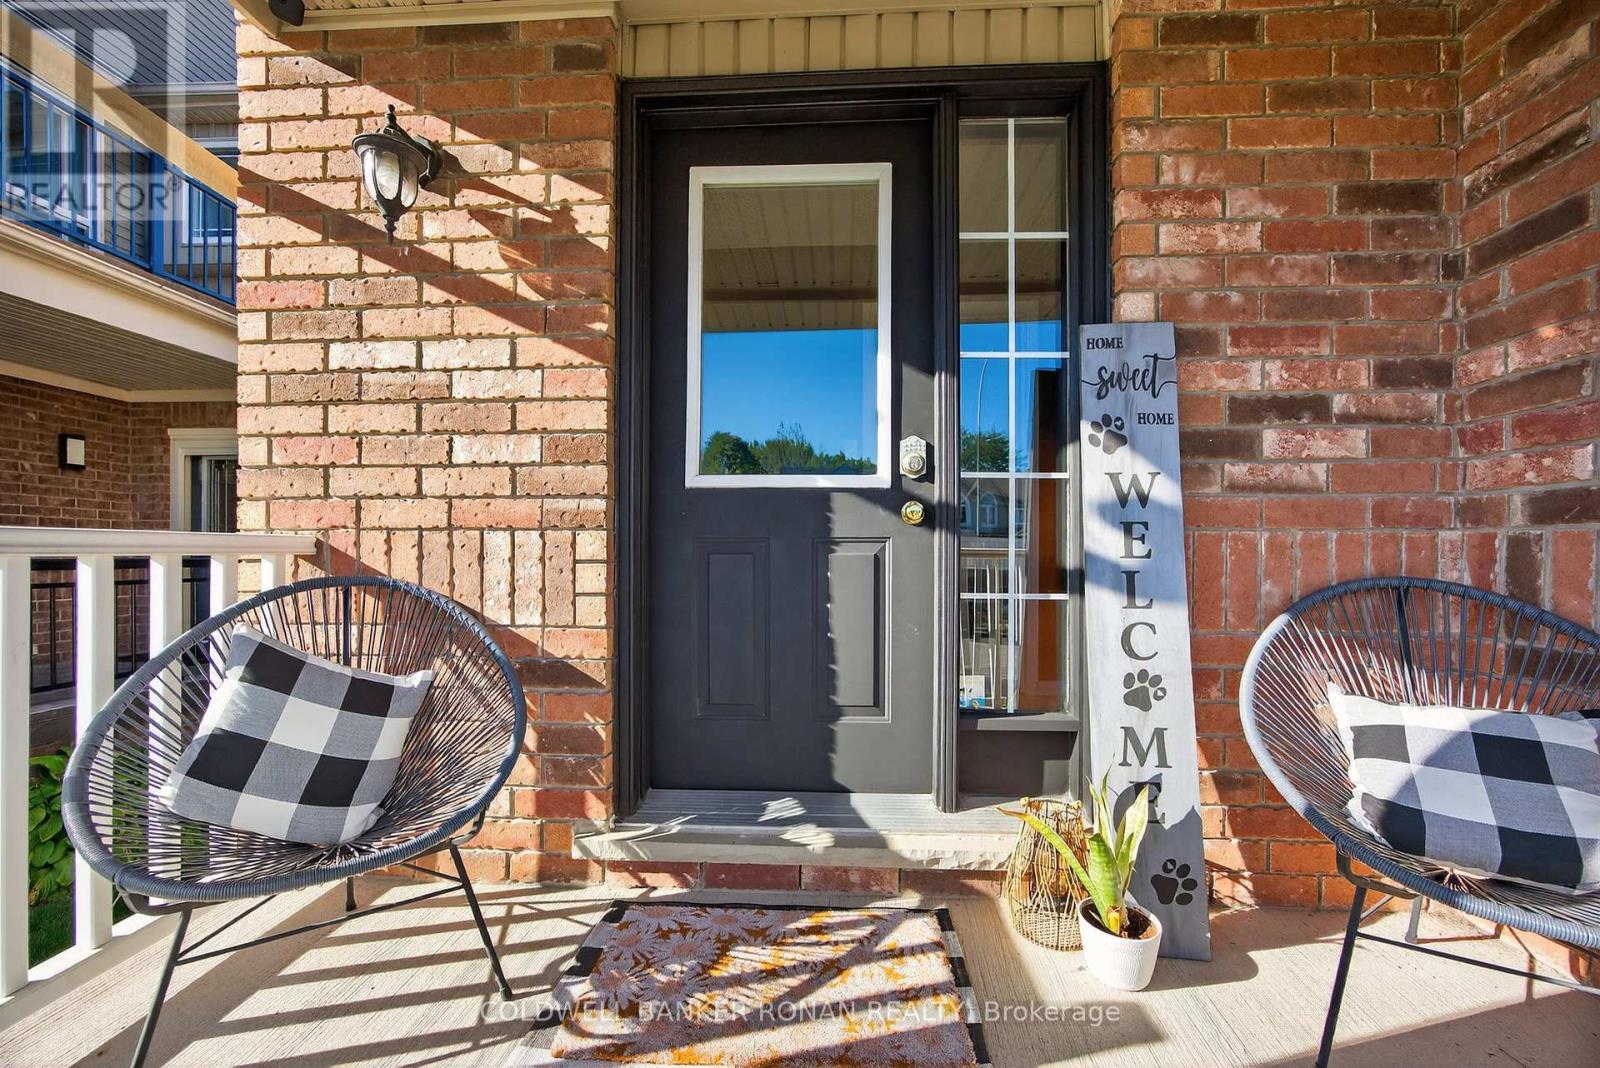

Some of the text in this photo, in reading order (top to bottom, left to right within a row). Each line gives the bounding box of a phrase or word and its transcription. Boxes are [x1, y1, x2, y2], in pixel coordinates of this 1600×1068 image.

[1086, 337, 1124, 350] HOME
[1081, 353, 1178, 401] sweet
[1137, 412, 1175, 425] HOME
